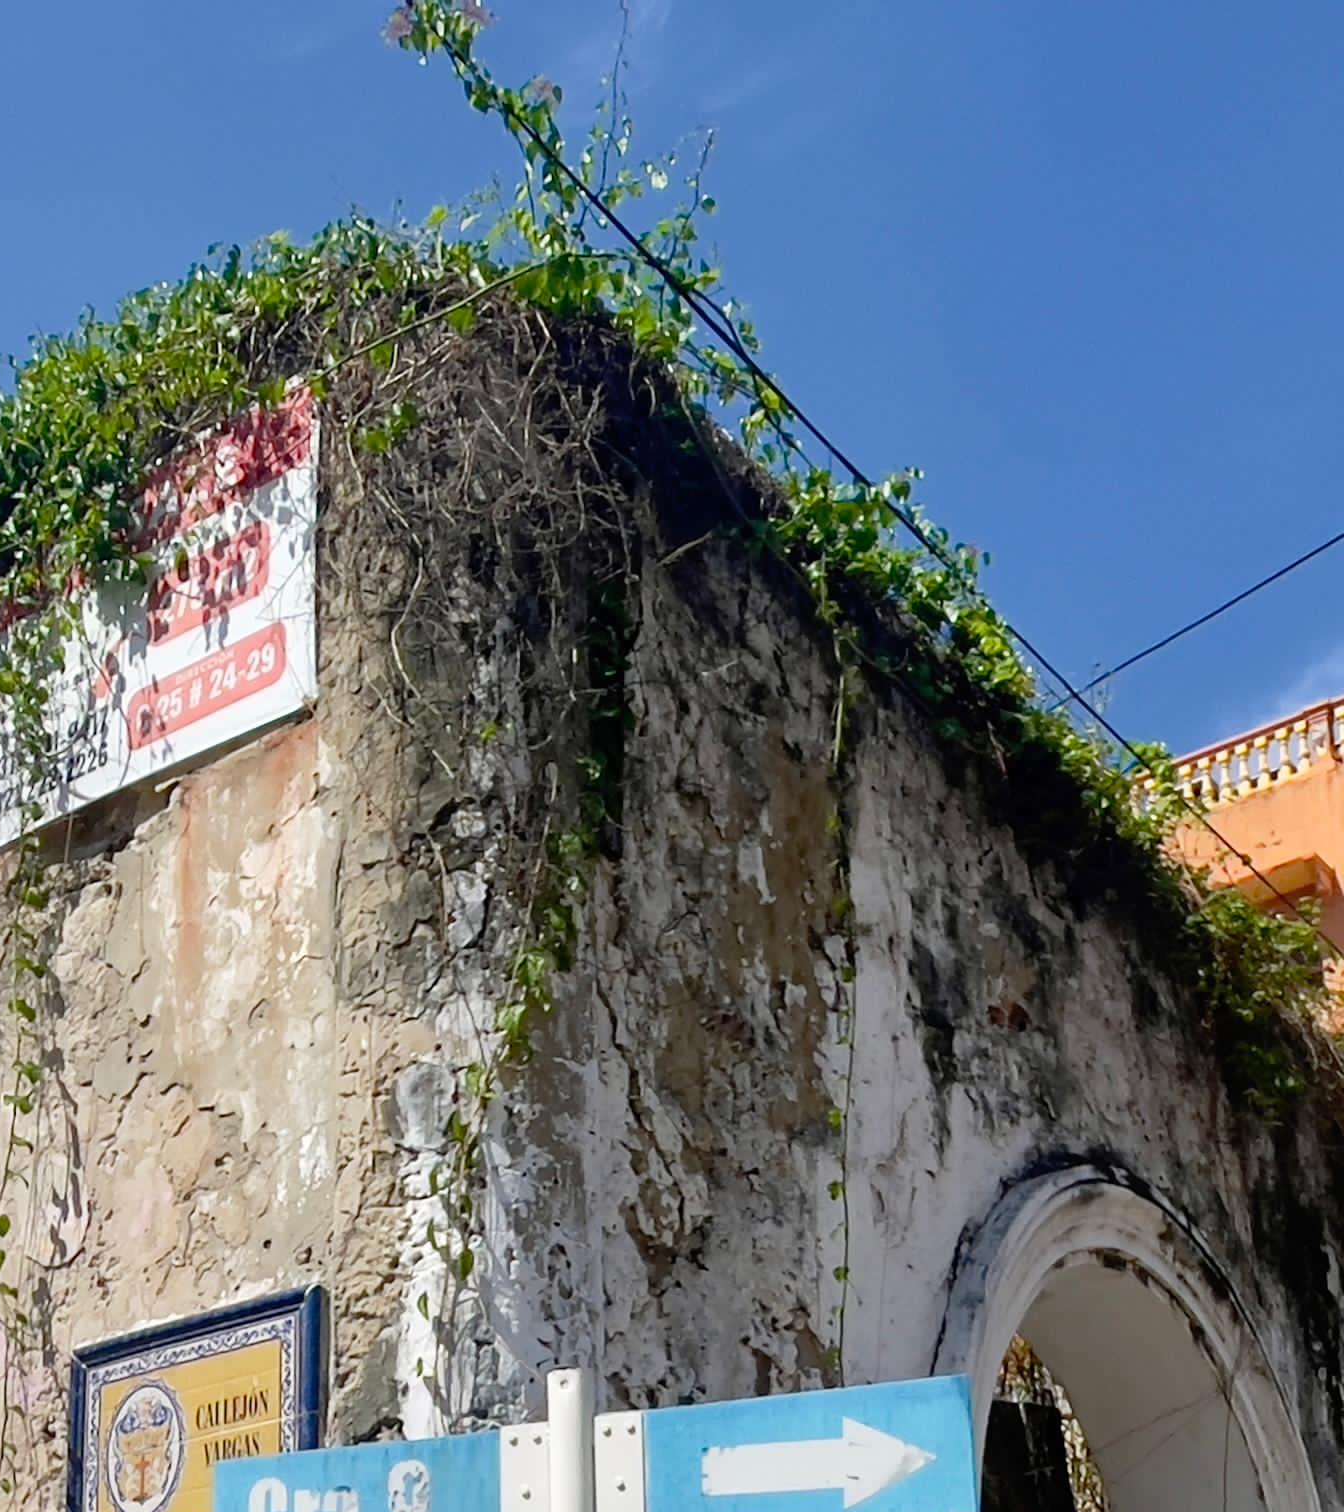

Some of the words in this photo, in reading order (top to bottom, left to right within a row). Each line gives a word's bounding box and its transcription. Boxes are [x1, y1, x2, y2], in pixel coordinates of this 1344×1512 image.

[157, 687, 182, 721] 25
[189, 680, 202, 708] #
[209, 643, 275, 699] 24-29
[196, 1387, 269, 1430] CALLEJÓN
[201, 1432, 260, 1468] VARGAS
